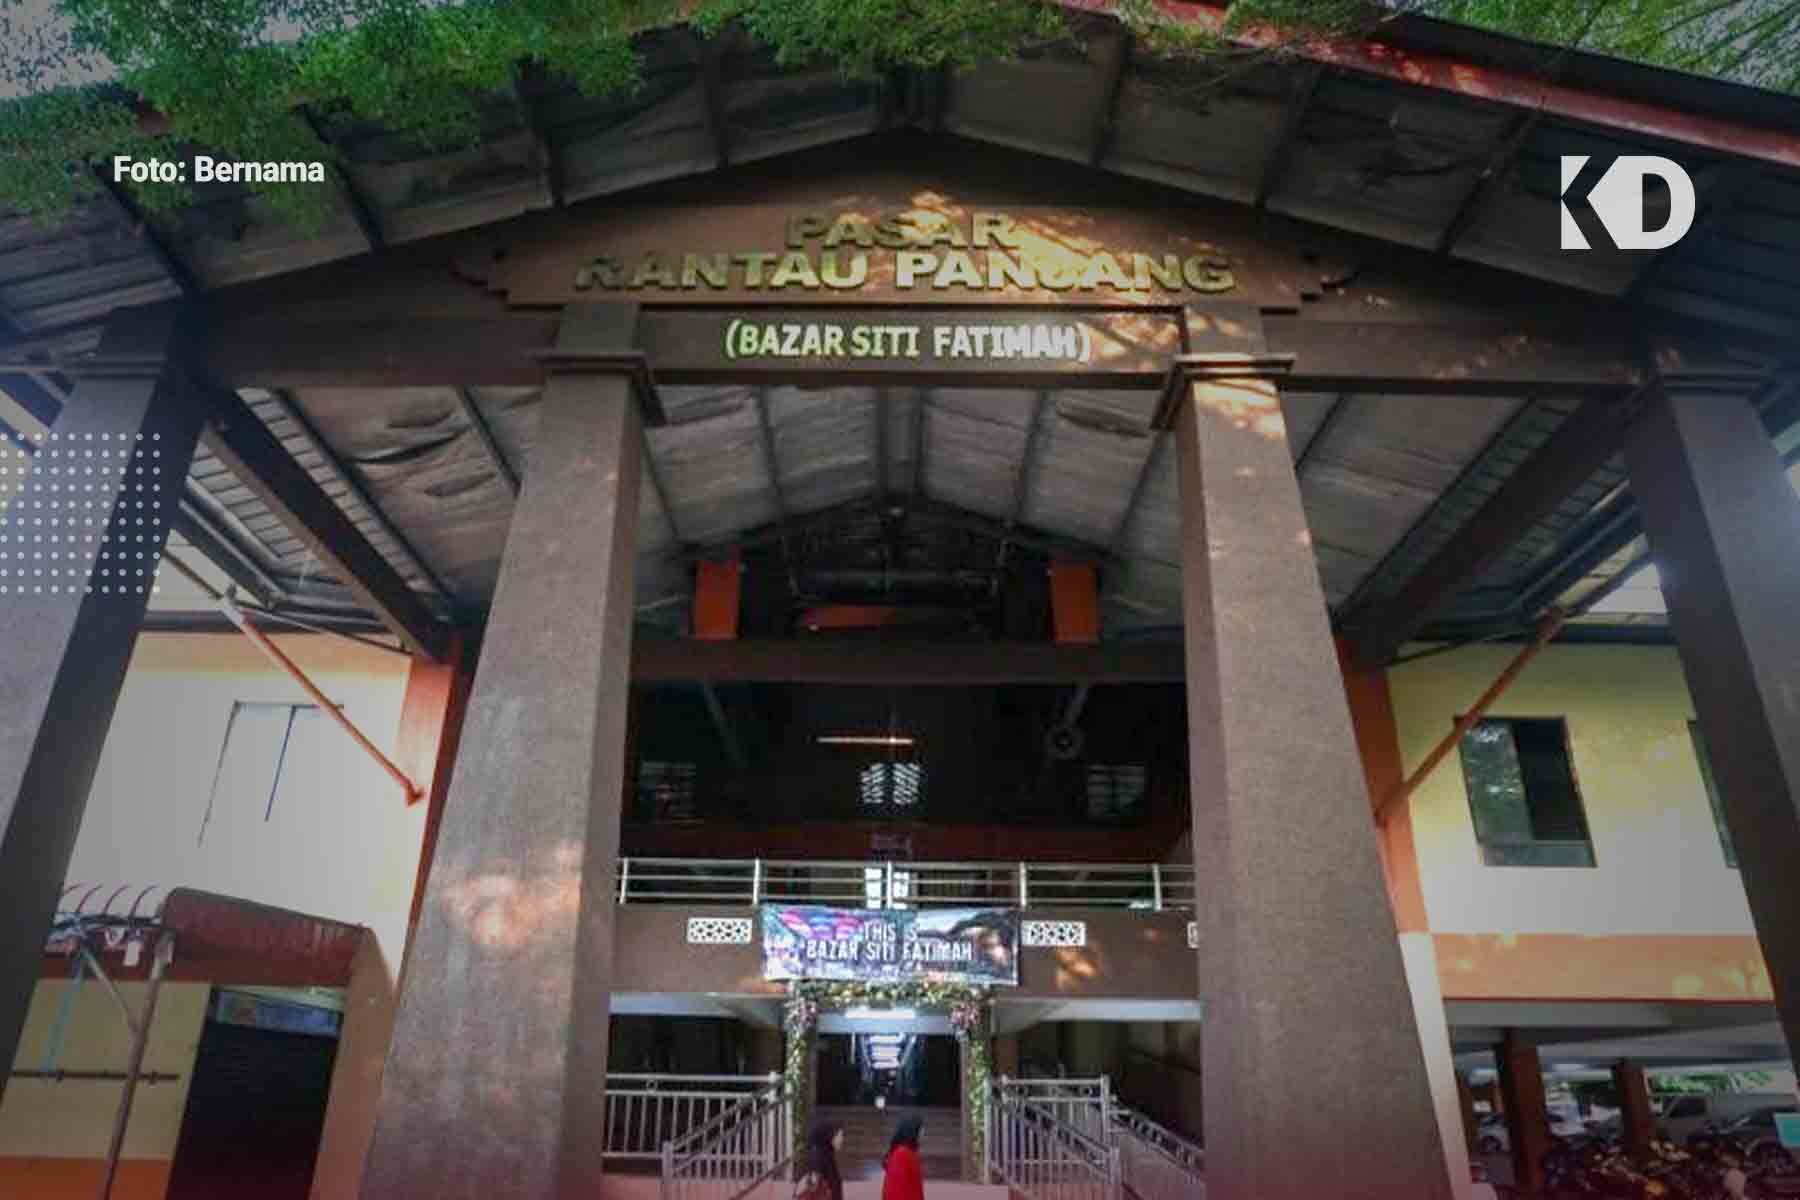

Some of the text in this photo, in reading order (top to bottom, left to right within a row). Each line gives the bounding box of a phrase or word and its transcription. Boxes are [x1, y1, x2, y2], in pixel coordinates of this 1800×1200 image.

[785, 211, 1018, 248] PASAR
[575, 250, 869, 290] RANTAU
[724, 319, 1091, 361] (BAZAR SITI FATIMAH)
[863, 920, 897, 941] THIS
[806, 940, 859, 961] BAZAR
